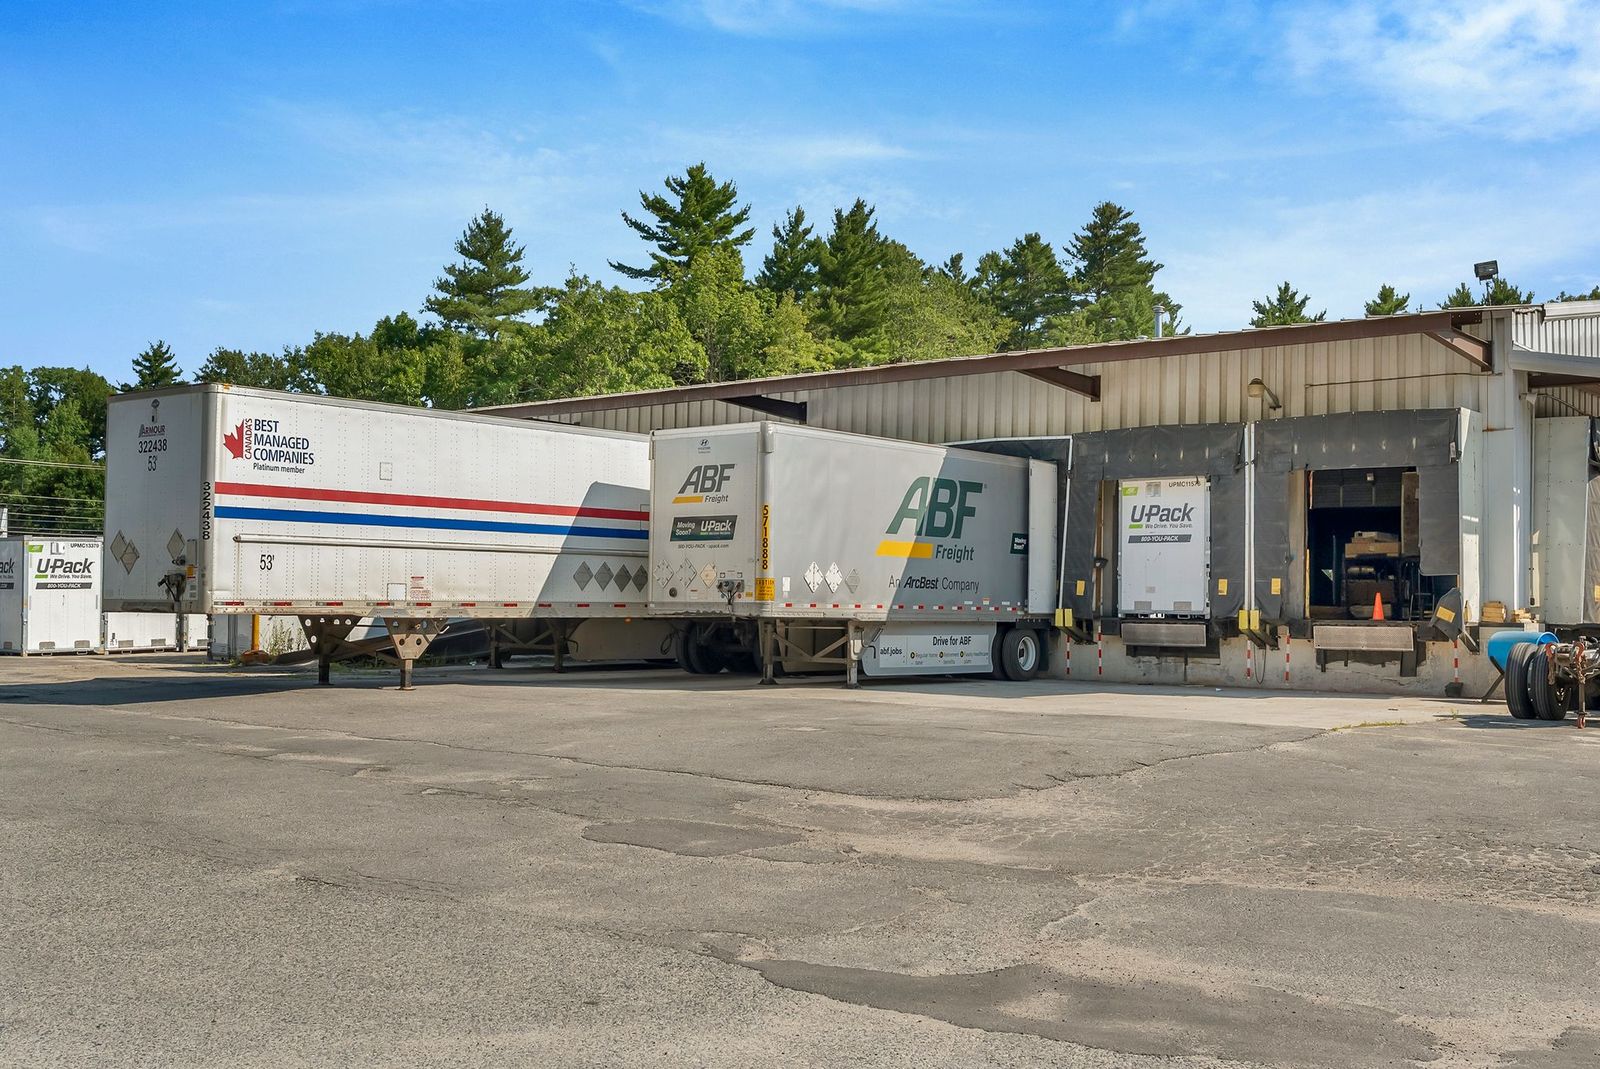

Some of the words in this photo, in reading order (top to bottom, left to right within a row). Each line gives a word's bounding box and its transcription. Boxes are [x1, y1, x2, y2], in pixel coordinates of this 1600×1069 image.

[254, 418, 279, 433] BEST
[138, 438, 168, 454] 322438
[245, 418, 253, 460] CANADA'S
[254, 433, 310, 450] MANAGED
[147, 455, 157, 471] 53
[253, 448, 315, 465] COMPANIES
[253, 462, 280, 472] Platinum
[280, 465, 306, 474] member
[677, 463, 736, 495] ABF
[704, 495, 729, 504] Freight
[202, 481, 211, 541] 322438
[885, 476, 984, 540] ABF
[1130, 503, 1195, 523] U-Pack
[675, 528, 692, 536] Soon?
[676, 521, 696, 530] Moving
[700, 519, 732, 532] U-Pack
[935, 544, 975, 564] Freight
[36, 557, 95, 574] U-Pack
[888, 574, 900, 589] An
[903, 576, 940, 590] ArcBest
[941, 576, 980, 594] Company
[932, 635, 949, 646] Drive
[949, 635, 959, 646] for
[959, 635, 972, 646] ABF
[880, 646, 903, 657] abf.jobs
